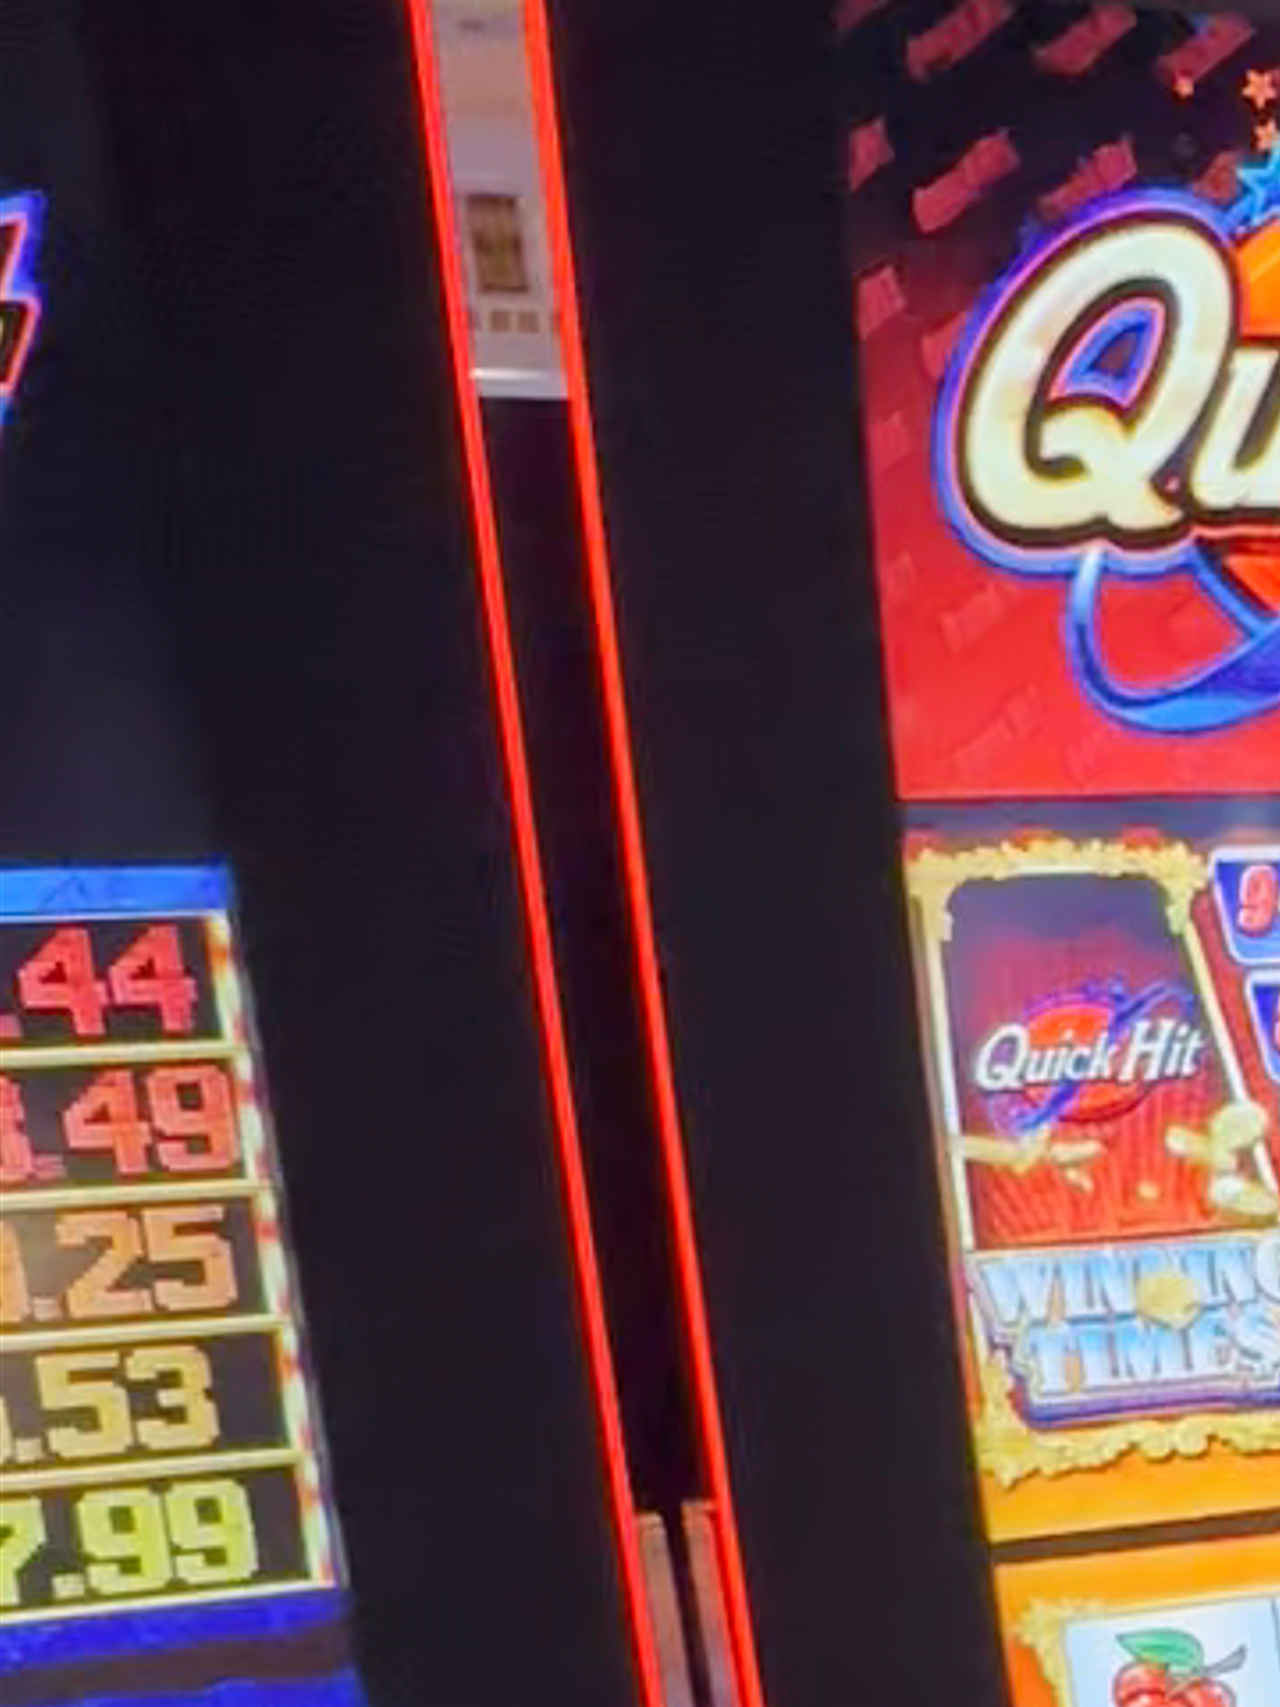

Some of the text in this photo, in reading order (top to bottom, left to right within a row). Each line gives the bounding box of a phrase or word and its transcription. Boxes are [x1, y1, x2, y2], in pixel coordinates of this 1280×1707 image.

[1237, 865, 1276, 936] 9
[974, 1015, 1206, 1092] Quick Hit
